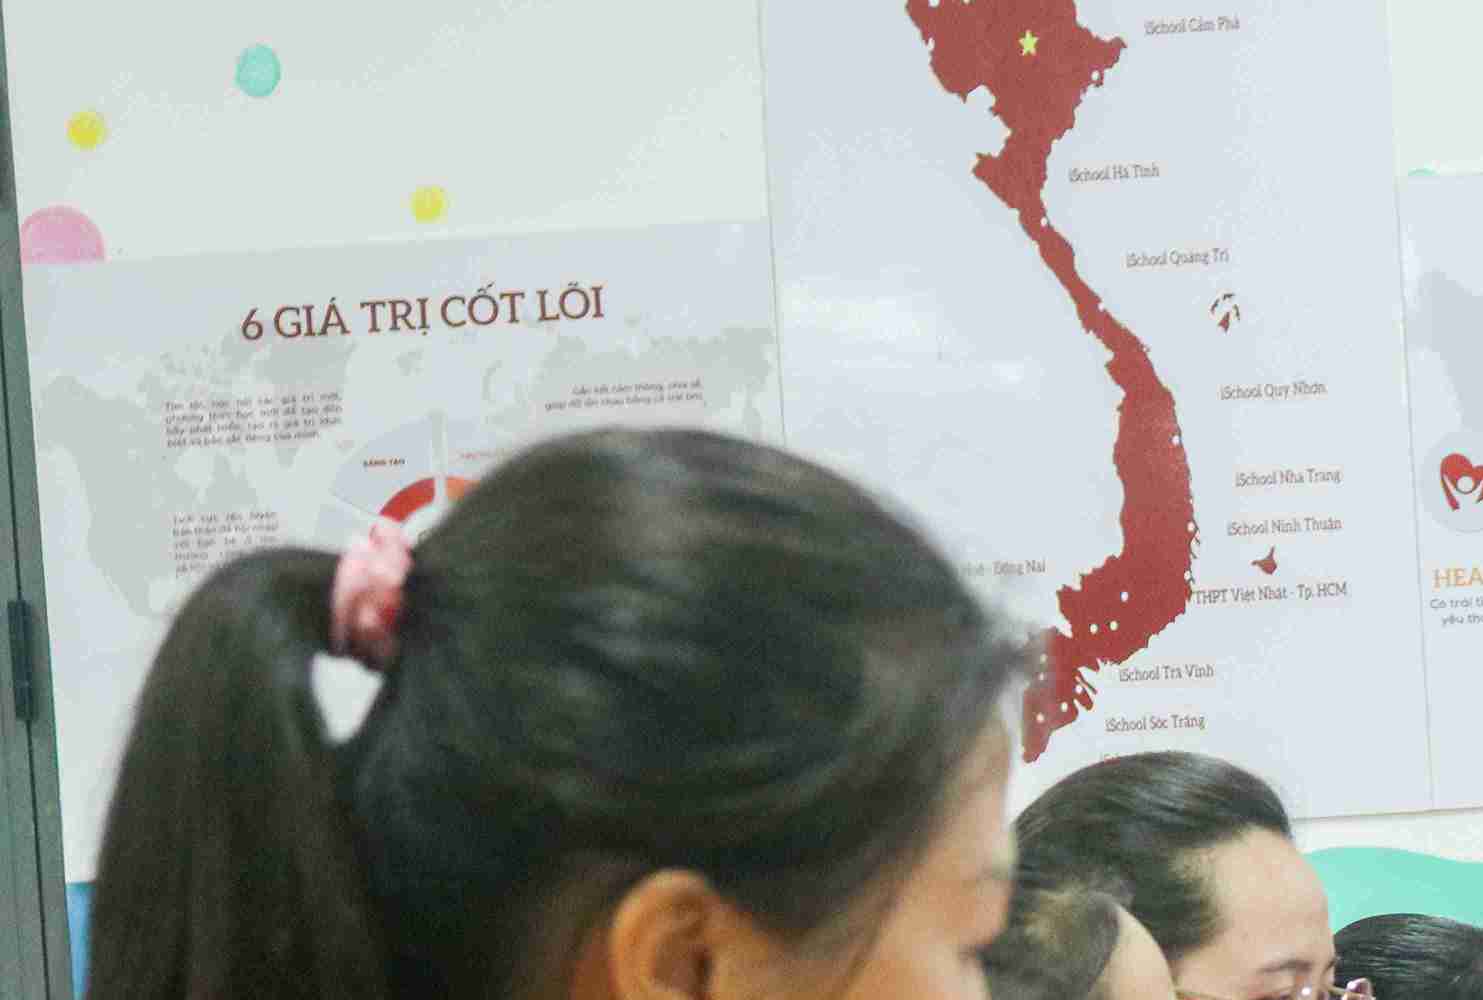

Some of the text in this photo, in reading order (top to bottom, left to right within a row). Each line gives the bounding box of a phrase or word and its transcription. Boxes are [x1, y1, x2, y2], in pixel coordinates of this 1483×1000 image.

[1143, 18, 1185, 35] iSchool
[1068, 164, 1110, 183] iSchool
[1126, 250, 1168, 268] iSchool
[241, 281, 605, 341] 6 GIÁ TRỊ CỐT LÕI
[1220, 384, 1262, 401] iSchool
[1235, 467, 1343, 488] iSchool Nha Trang
[1227, 519, 1268, 537] iSchool
[1271, 518, 1302, 535] Ninh
[1195, 587, 1228, 605] THPT
[1316, 580, 1348, 598] HCM
[1119, 665, 1160, 682] iSchool
[1184, 663, 1215, 679] Vinh
[1105, 715, 1147, 733] iSchool
